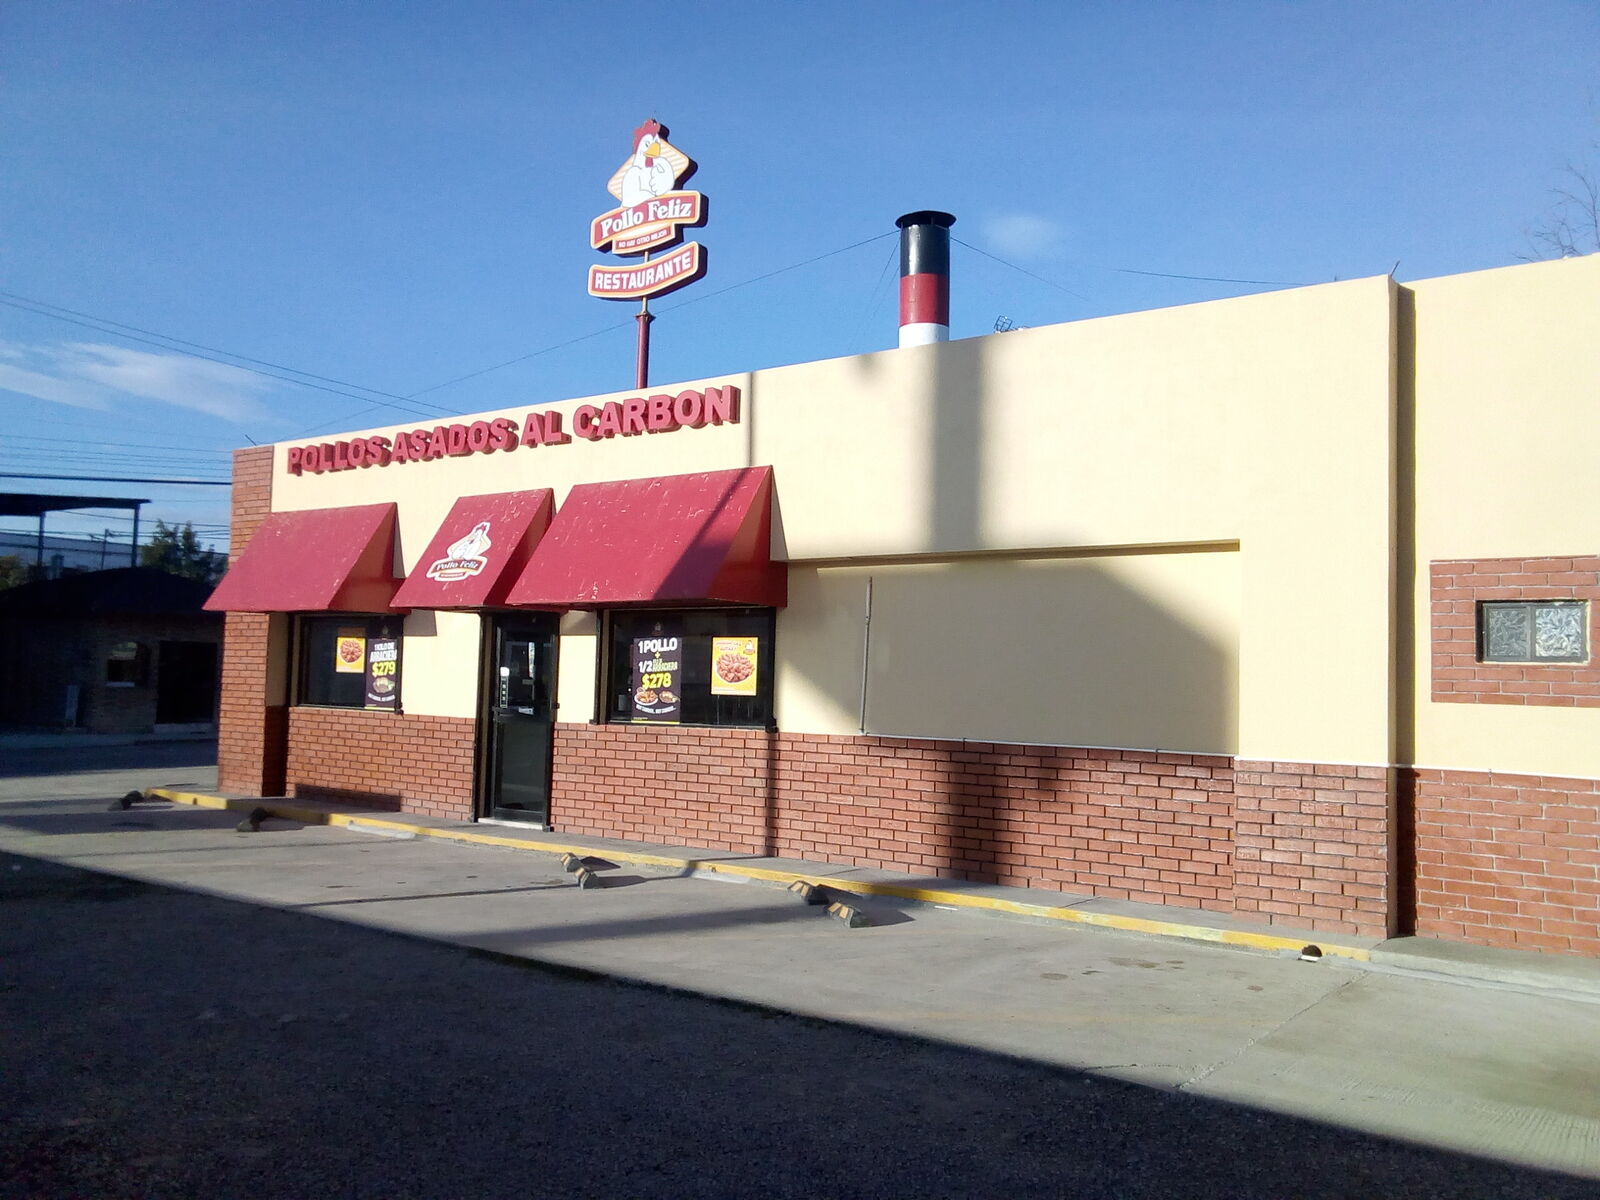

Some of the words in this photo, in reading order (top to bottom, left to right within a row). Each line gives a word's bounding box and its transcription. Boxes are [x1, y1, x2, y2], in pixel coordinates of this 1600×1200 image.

[600, 206, 645, 239] Pollo
[647, 198, 693, 222] Feliz
[594, 250, 692, 290] RESTAURANTE
[287, 436, 391, 476] POLLOS
[391, 417, 519, 464] ASADOS
[520, 410, 572, 449] AL
[573, 385, 741, 441] CARBON
[638, 640, 644, 654] 1
[643, 637, 678, 653] POLLO
[372, 661, 396, 677] $279
[638, 660, 653, 673] 1/2
[641, 672, 672, 690] $278
